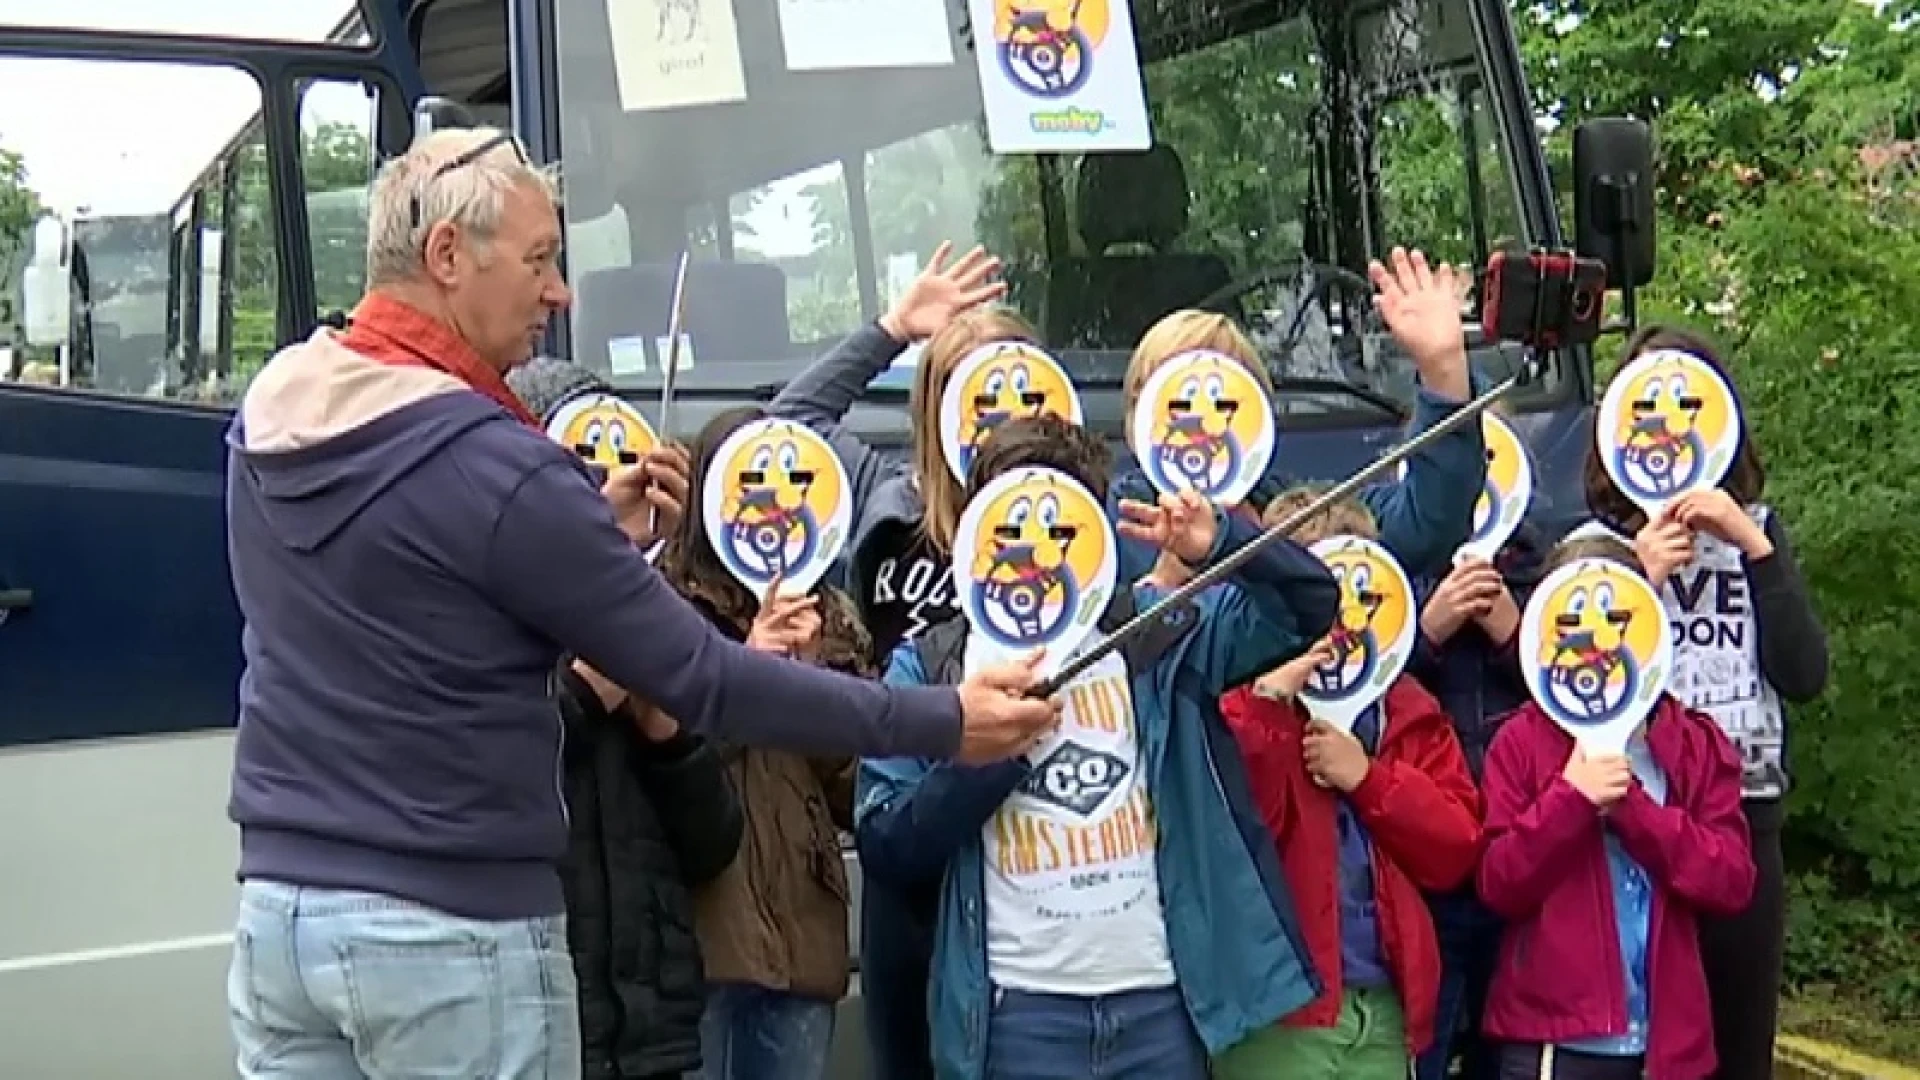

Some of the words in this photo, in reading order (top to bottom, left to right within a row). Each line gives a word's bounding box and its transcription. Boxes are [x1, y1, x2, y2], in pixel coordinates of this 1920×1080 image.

[1029, 105, 1104, 136] moby
[873, 556, 961, 608] ROC
[1666, 567, 1744, 615] VE
[1668, 616, 1744, 650] DON
[993, 786, 1157, 876] AMSTERDA
